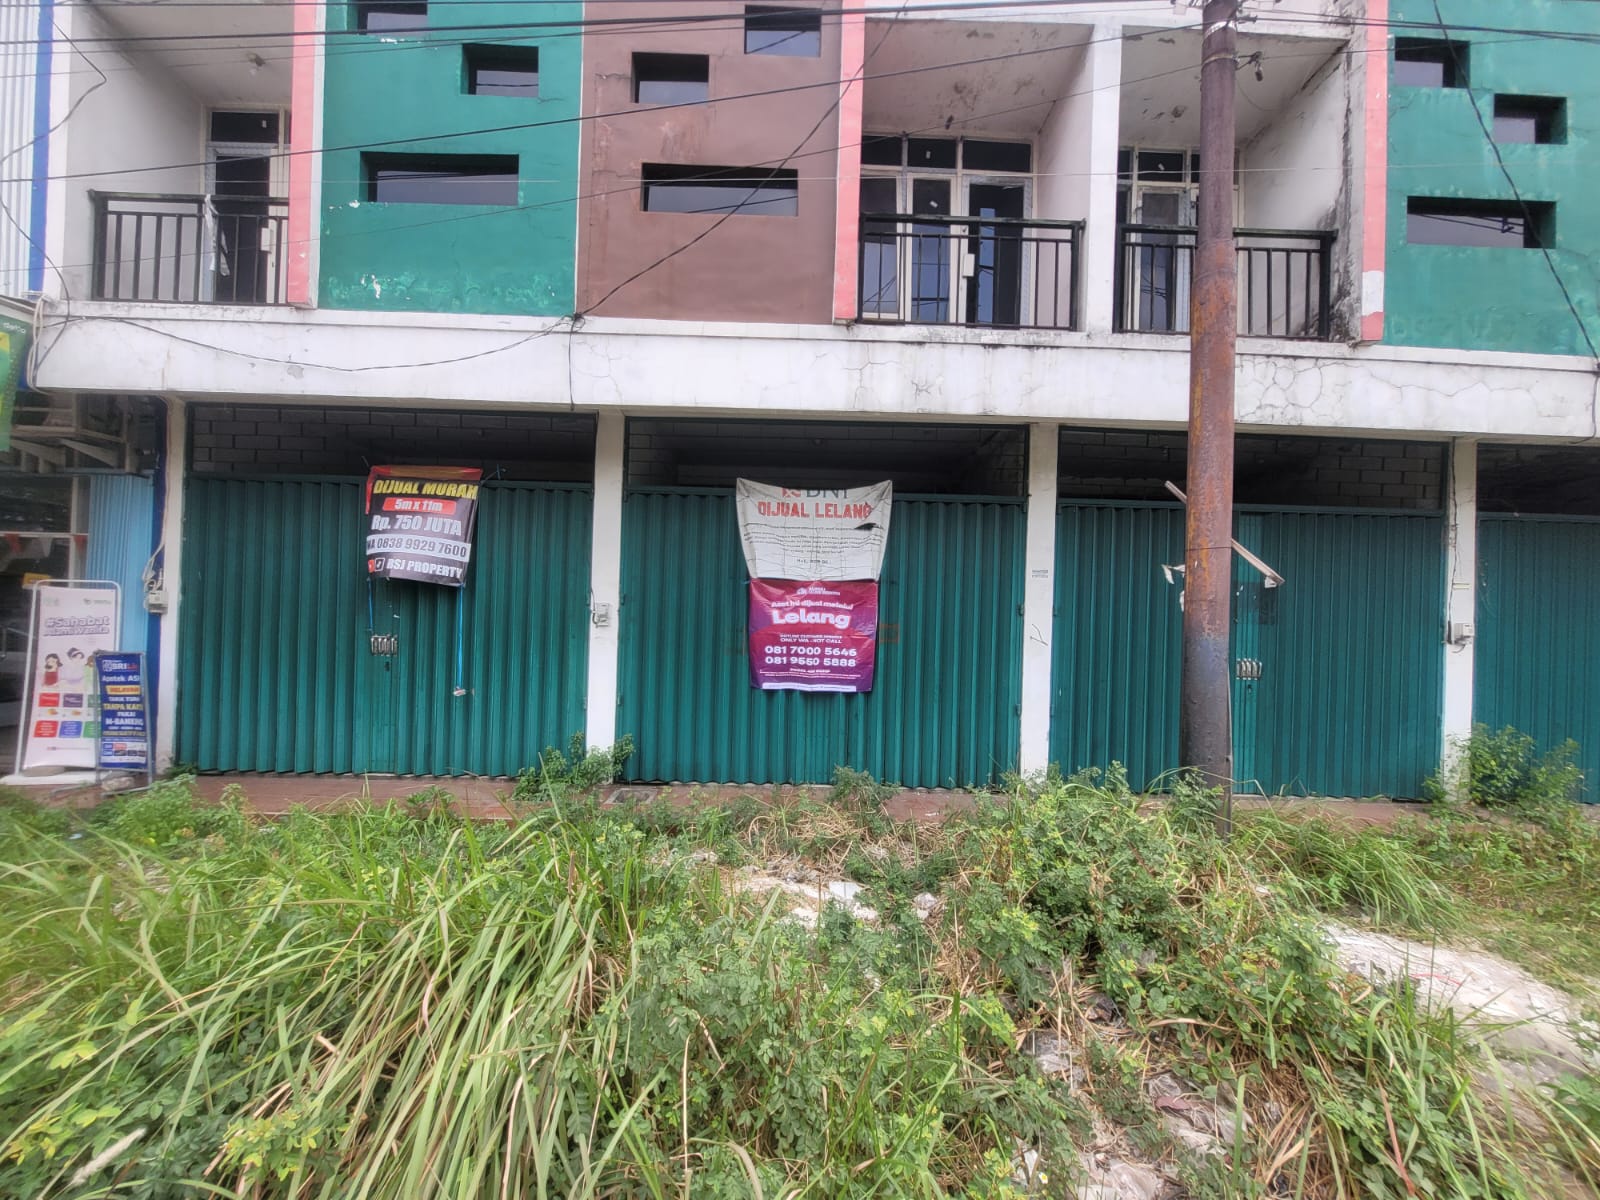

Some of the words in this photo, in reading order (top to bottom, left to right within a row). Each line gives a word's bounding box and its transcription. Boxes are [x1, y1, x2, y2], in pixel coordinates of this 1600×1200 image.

[373, 480, 420, 494] DIJUAL
[421, 482, 478, 500] MURAH
[394, 499, 411, 510] 5m
[422, 501, 443, 512] 11m
[758, 501, 810, 518] DIJUAL
[371, 515, 391, 531] Rp.
[394, 515, 423, 530] 750
[424, 517, 462, 536] JUTA
[377, 537, 403, 549] 0838
[404, 539, 435, 552] 9929
[437, 542, 467, 558] 7600
[406, 560, 463, 579] PROPERTY
[772, 608, 851, 630] Lelang
[764, 645, 787, 654] 081
[789, 646, 821, 655] 7000
[824, 647, 857, 657] 5646
[764, 656, 787, 664] 081
[823, 658, 856, 667] 5888
